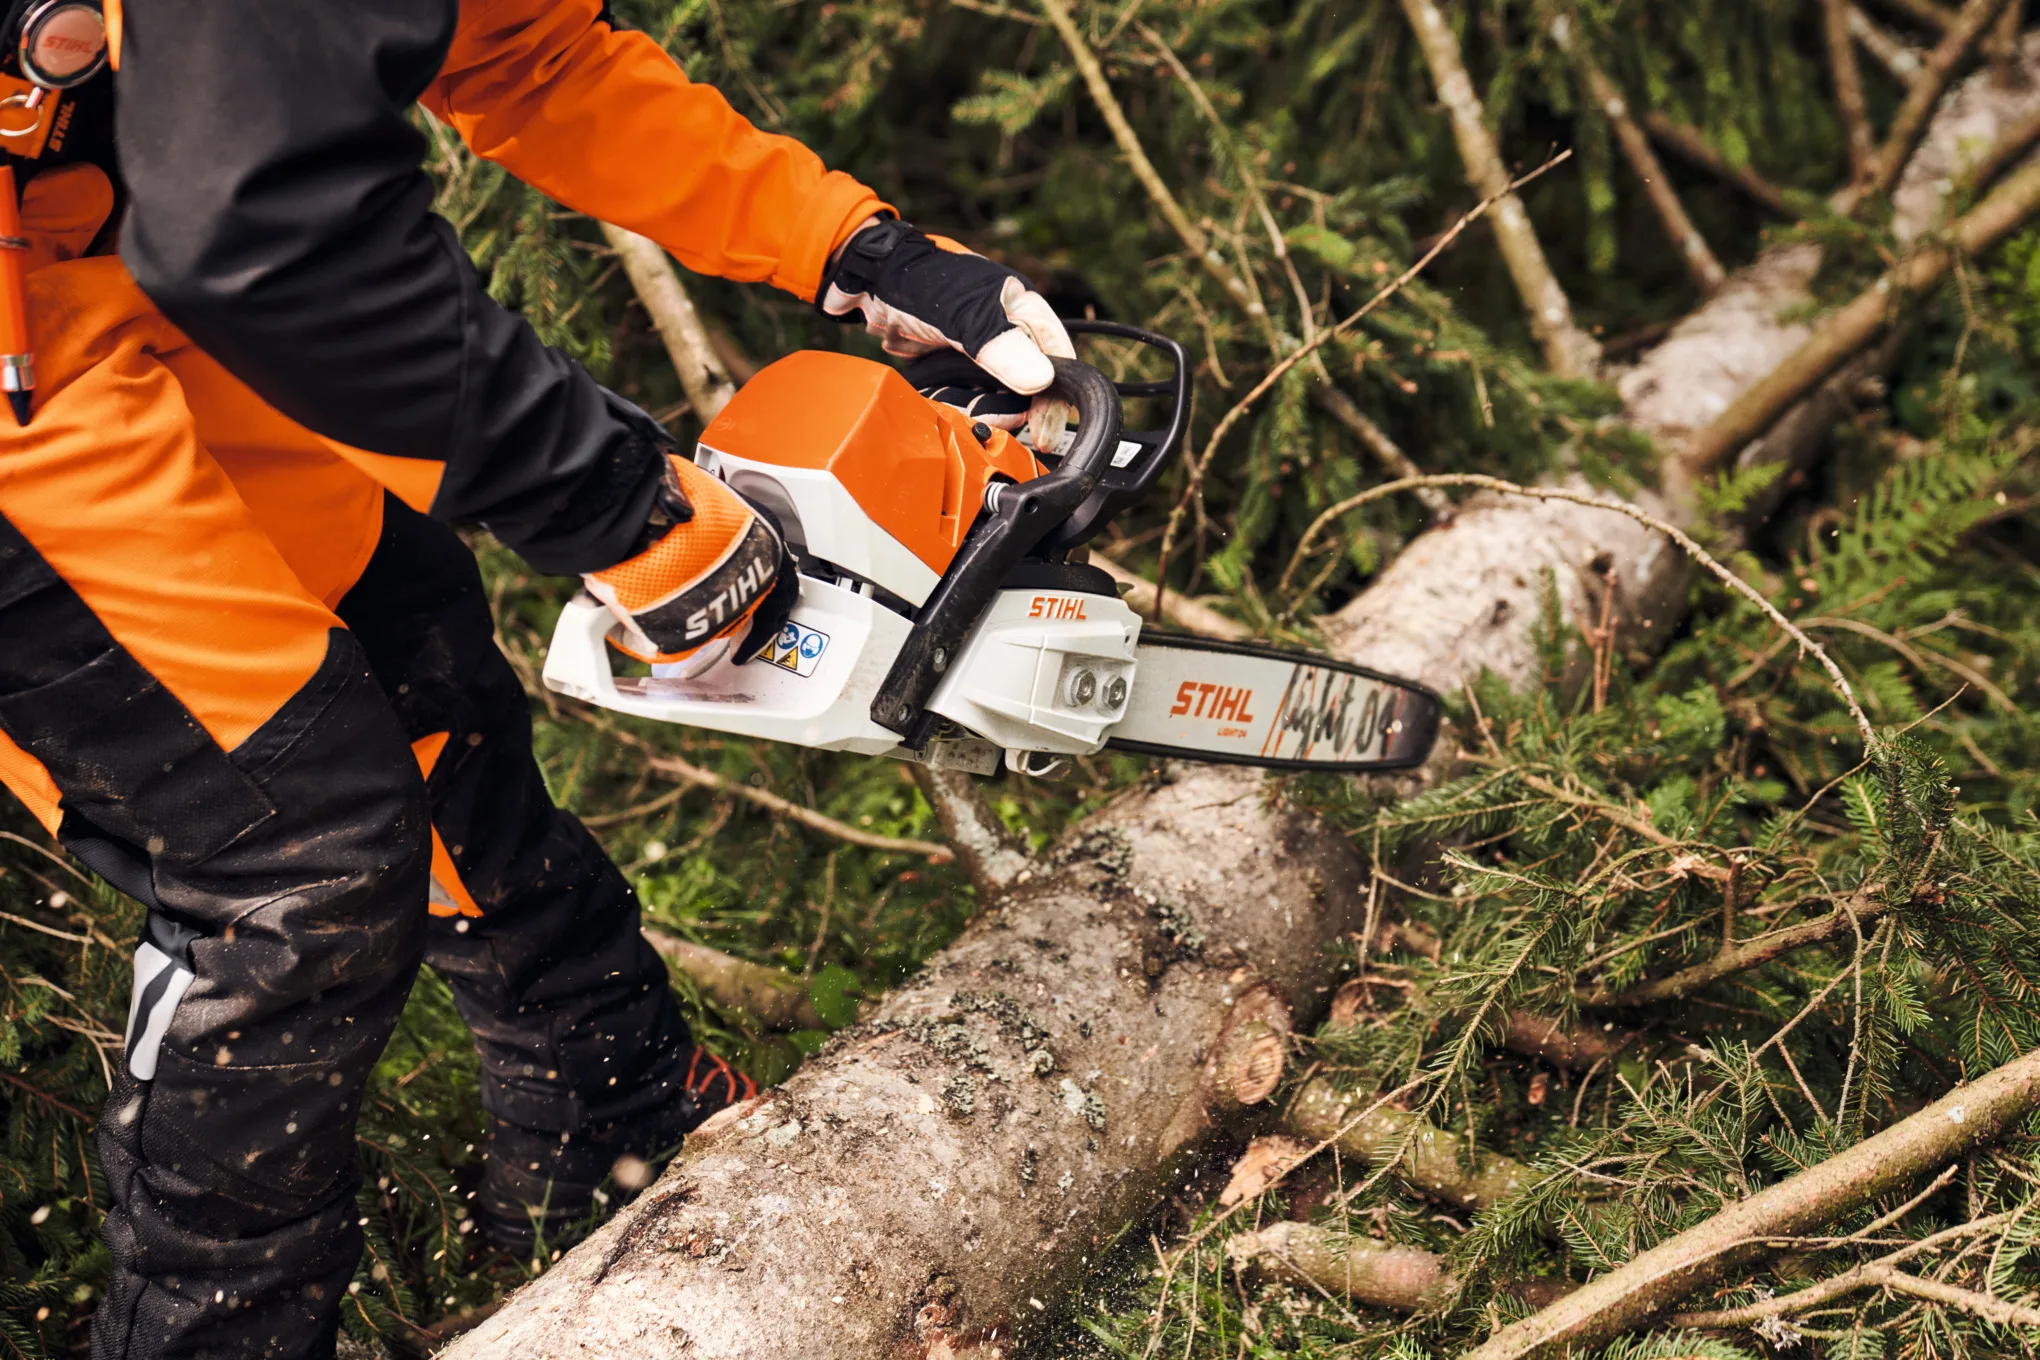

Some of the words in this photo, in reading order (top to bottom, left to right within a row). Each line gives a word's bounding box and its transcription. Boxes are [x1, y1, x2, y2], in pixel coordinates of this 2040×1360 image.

[43, 36, 93, 53] STIHL
[50, 101, 75, 152] STIHL
[685, 556, 774, 640] STIHL
[1028, 596, 1087, 620] STIHL
[1170, 681, 1254, 723] STIHL
